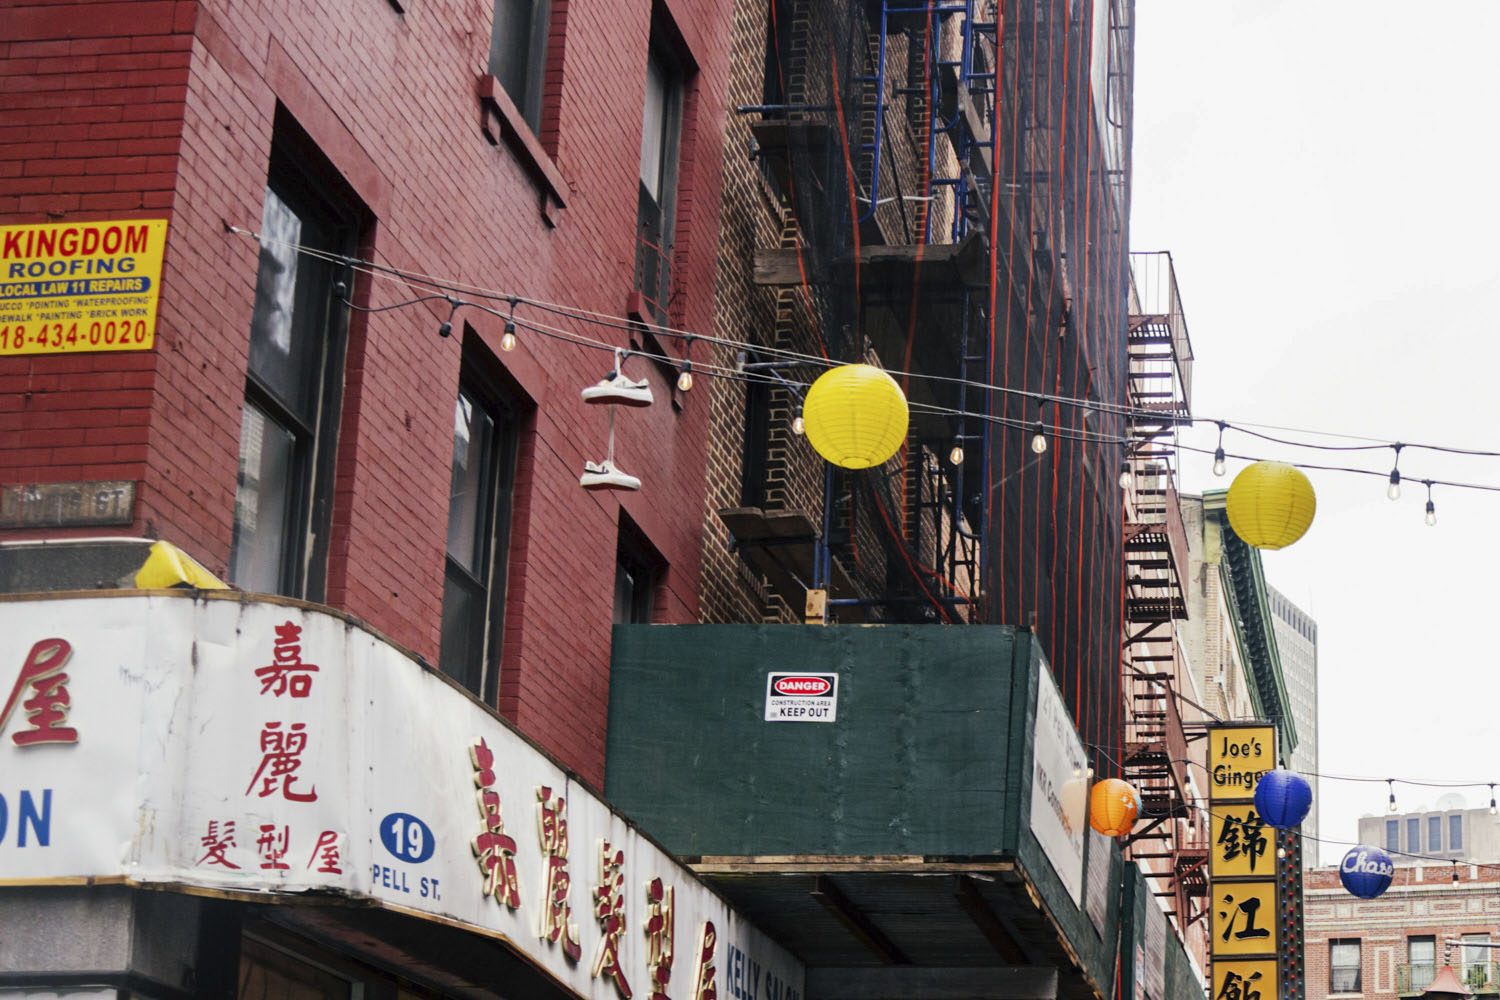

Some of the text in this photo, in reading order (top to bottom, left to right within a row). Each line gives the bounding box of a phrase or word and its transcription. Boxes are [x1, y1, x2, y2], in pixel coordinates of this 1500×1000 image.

[2, 225, 150, 260] KINGDOM
[8, 257, 136, 279] ROOFING
[0, 278, 144, 298] LOCAL LAW 11 REPAIRS
[120, 308, 148, 317] WORK
[779, 681, 826, 691] DANGER
[245, 620, 321, 804] 嘉麗
[780, 707, 829, 717] KEEP OUT
[1221, 736, 1263, 758] Joe's
[0, 788, 53, 849] N
[196, 820, 344, 876] 髮型屋
[391, 817, 425, 860] 19
[1343, 852, 1394, 878] Chase
[372, 863, 443, 903] PELL ST.
